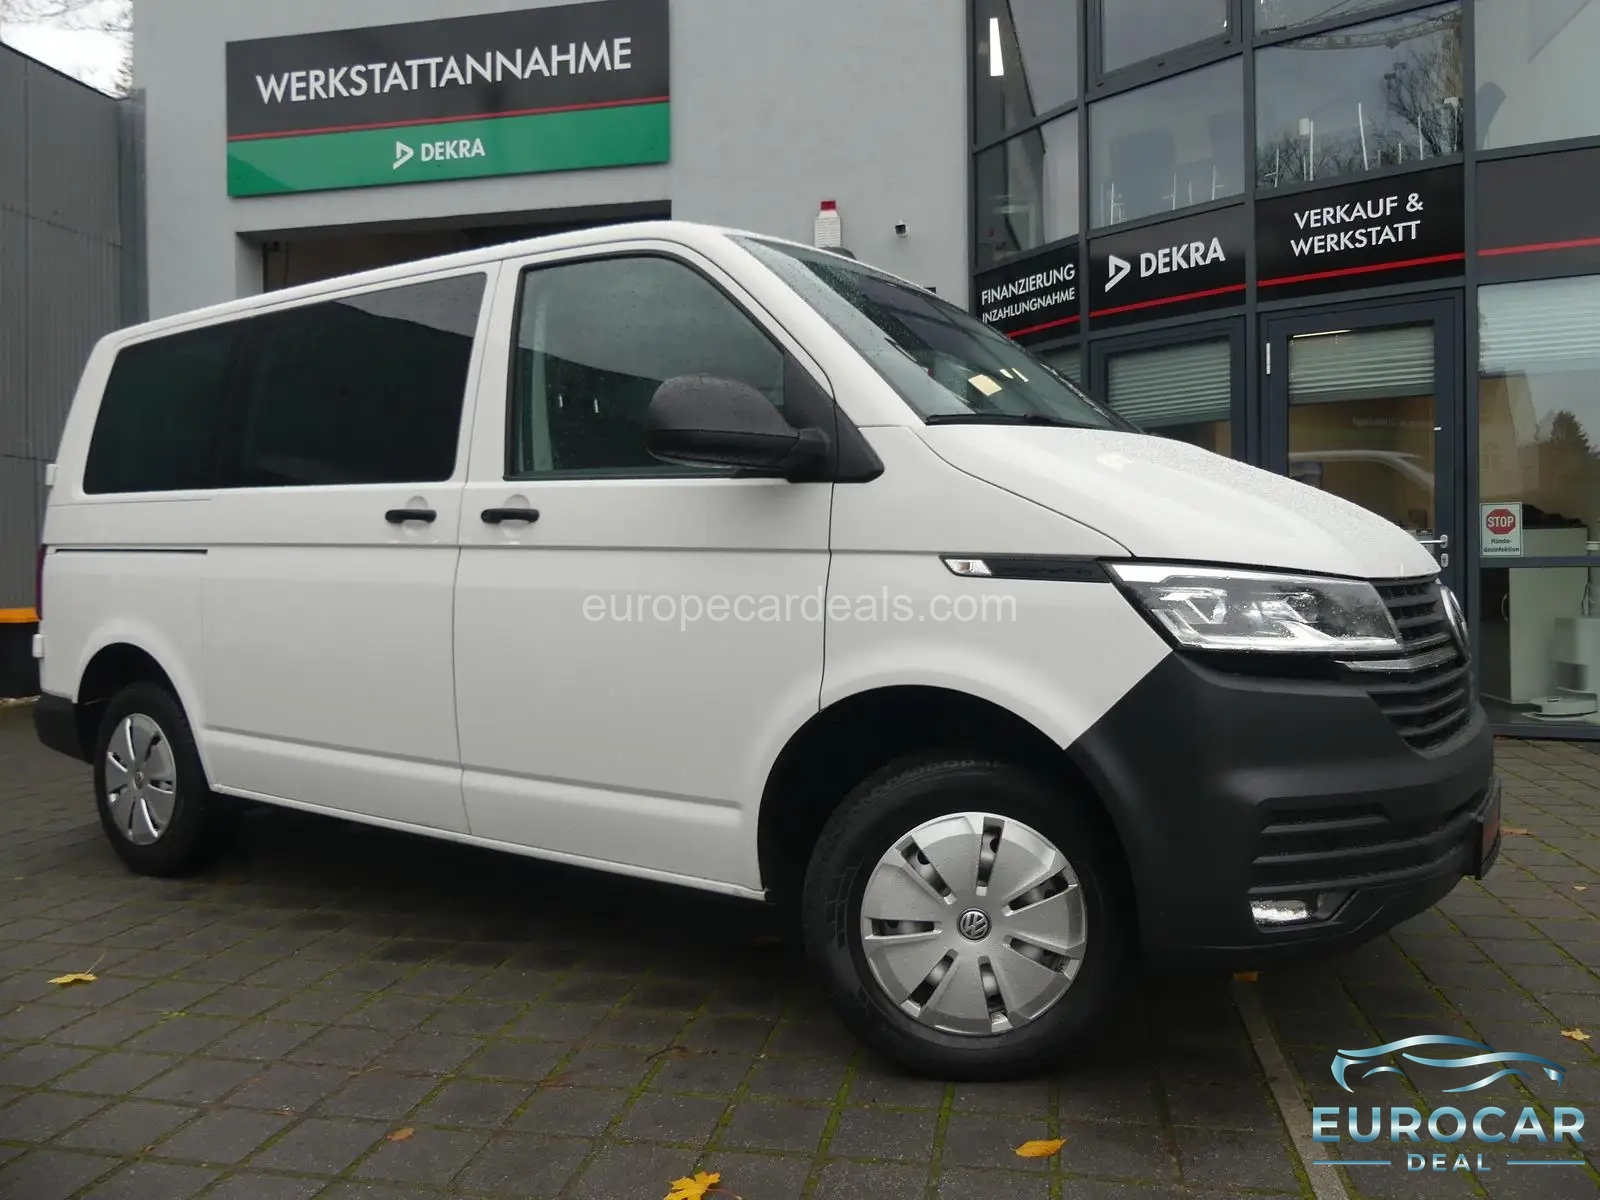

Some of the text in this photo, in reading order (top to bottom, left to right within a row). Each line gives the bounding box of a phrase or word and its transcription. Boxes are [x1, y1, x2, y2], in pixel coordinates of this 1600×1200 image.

[256, 37, 632, 105] WERKSTATTANNAHME
[421, 138, 485, 161] DEKRA
[1294, 192, 1424, 230] VERKAUF &
[1290, 220, 1421, 257] WERKSTATT
[1140, 237, 1226, 278] DEKRA
[981, 263, 1075, 305] FINANZIERUNG
[982, 287, 1075, 324] INZAHLUNGNAHME
[1487, 516, 1514, 528] STOP
